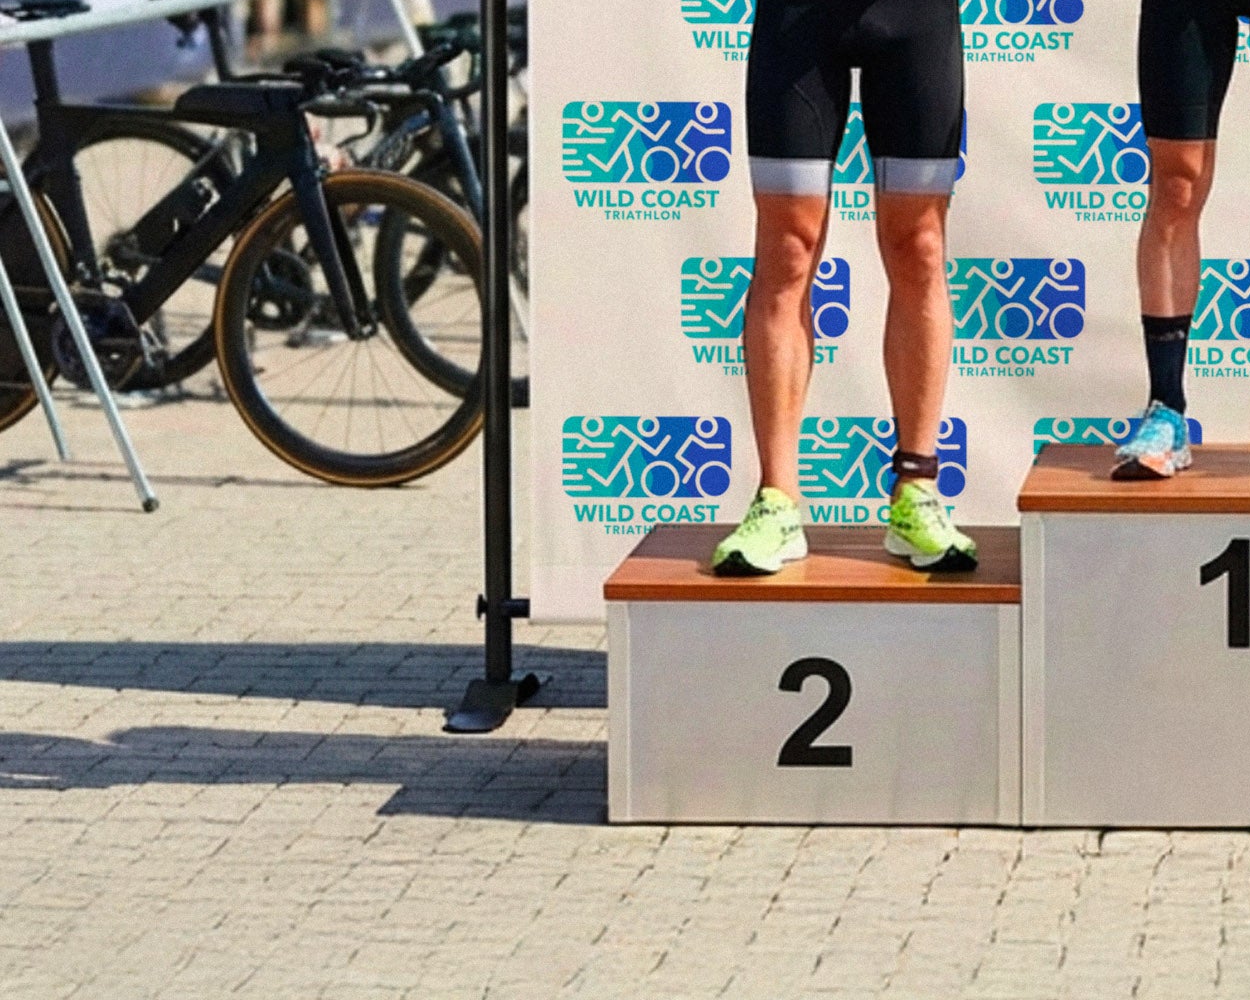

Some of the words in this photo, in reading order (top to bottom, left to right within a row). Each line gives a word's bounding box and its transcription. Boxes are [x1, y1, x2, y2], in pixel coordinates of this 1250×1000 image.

[691, 31, 752, 48] WILD
[960, 32, 988, 49] LD
[994, 31, 1074, 50] COAST
[573, 190, 634, 207] WILD
[640, 190, 719, 208] COAST
[833, 191, 870, 208] ILD
[1043, 192, 1105, 209] WILD
[605, 210, 680, 220] TRIATHLON
[840, 212, 876, 220] TRIAT
[952, 347, 988, 364] ILD
[994, 346, 1073, 364] COAST
[1187, 347, 1224, 365] ILD
[959, 367, 1034, 376] TRIATHLON
[573, 504, 634, 522] WILD
[640, 504, 720, 522] COAST
[808, 505, 870, 523] WILD
[605, 525, 656, 534] TRIATH
[1200, 539, 1250, 648] 1
[778, 658, 852, 767] 2
